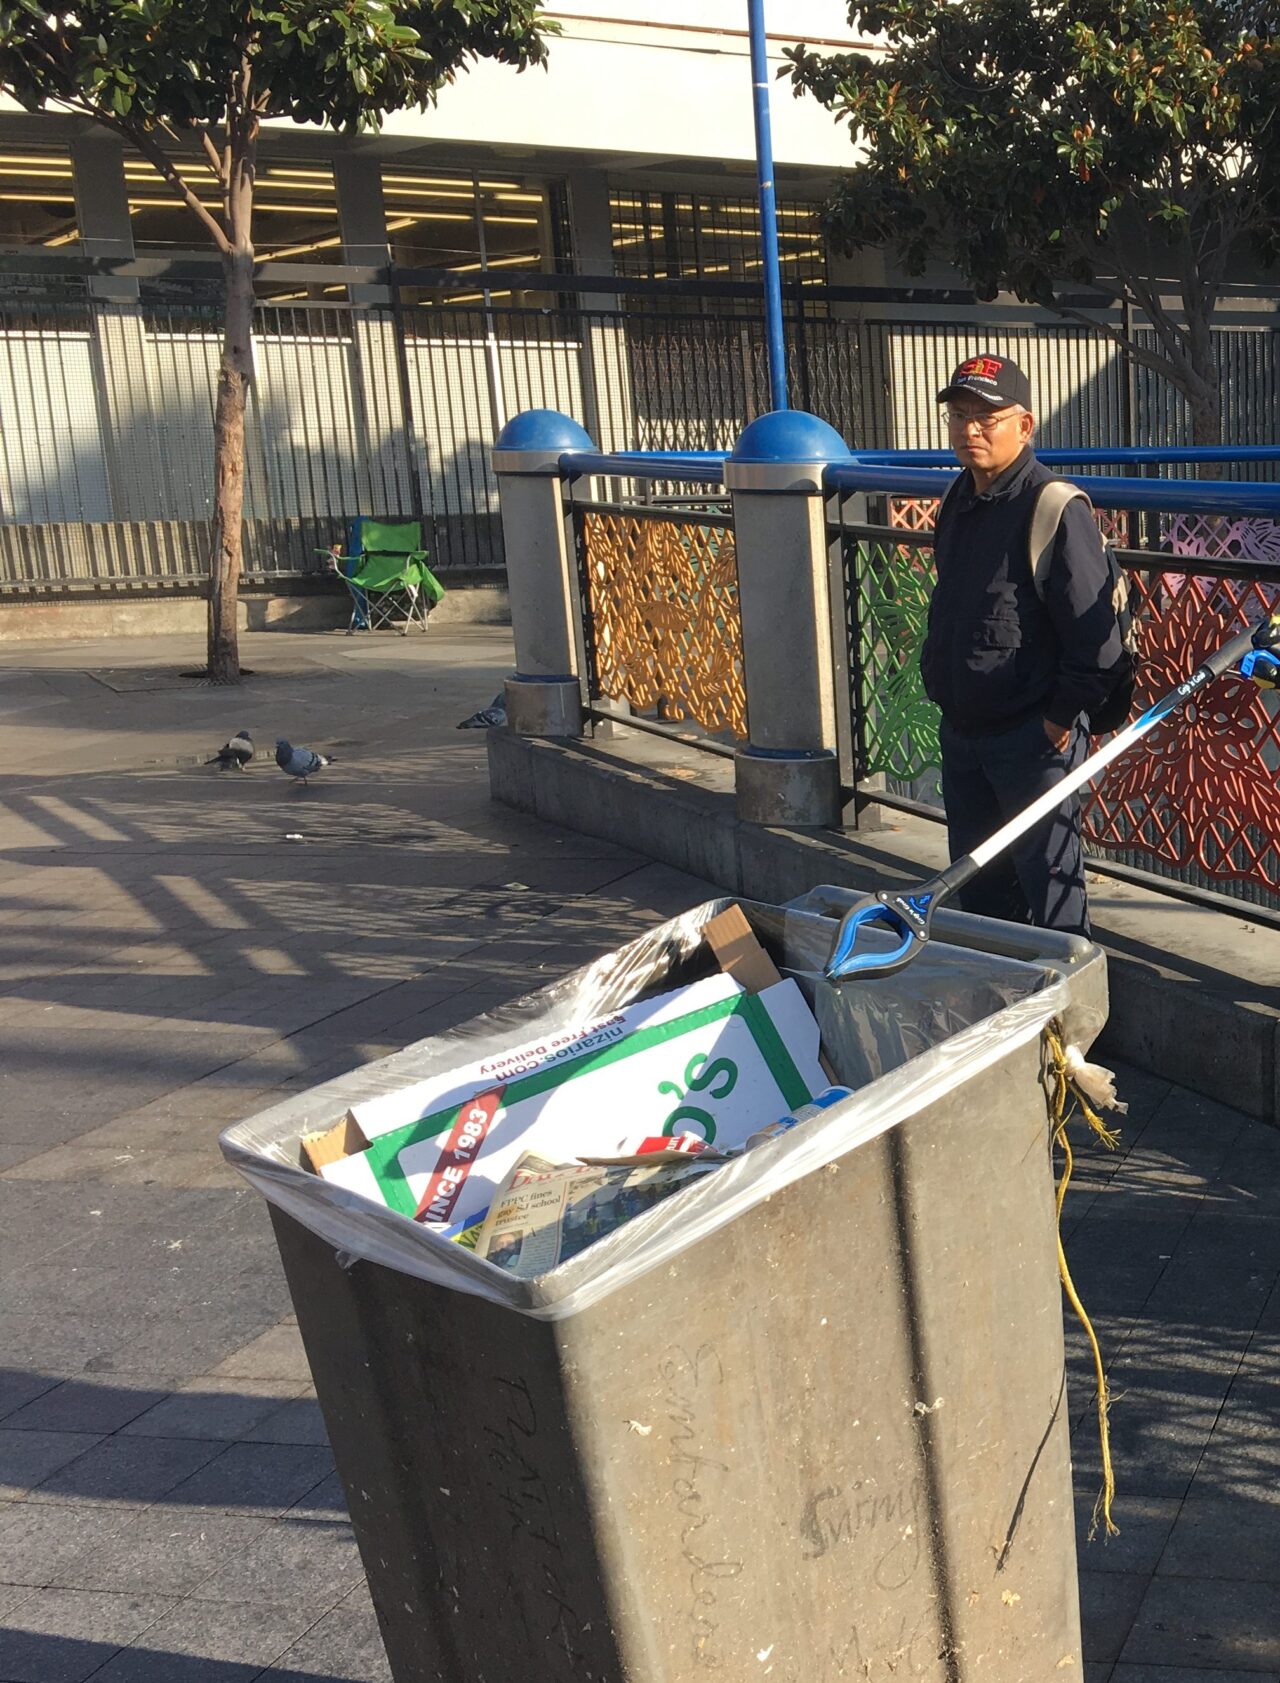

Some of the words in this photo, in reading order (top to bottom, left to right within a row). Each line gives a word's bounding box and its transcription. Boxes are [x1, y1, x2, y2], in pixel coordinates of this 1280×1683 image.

[551, 1029, 589, 1048] Free
[480, 1045, 547, 1075] Delivery
[495, 1026, 624, 1082] nizarios.com
[423, 1165, 464, 1224] INCE
[453, 1108, 488, 1160] 1983
[530, 1189, 553, 1201] fines
[531, 1195, 562, 1209] school
[495, 1213, 530, 1227] trustee
